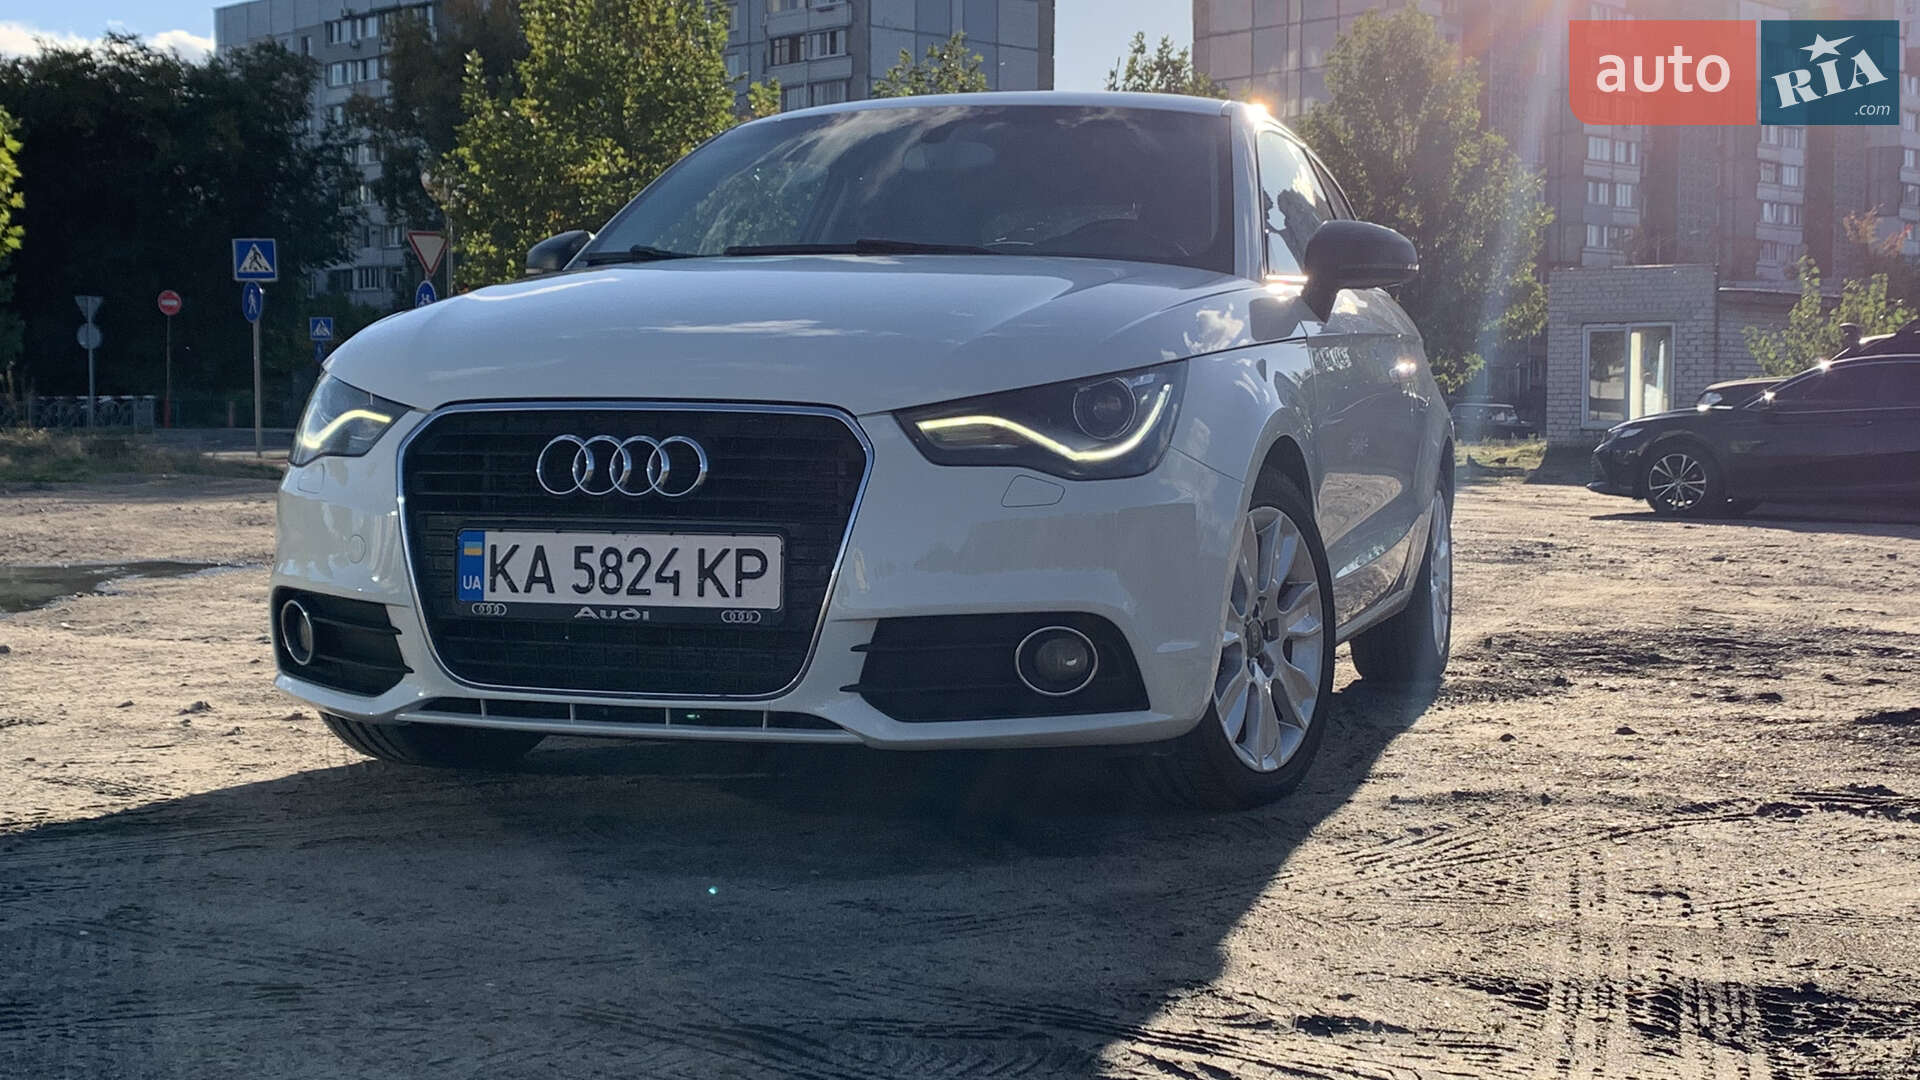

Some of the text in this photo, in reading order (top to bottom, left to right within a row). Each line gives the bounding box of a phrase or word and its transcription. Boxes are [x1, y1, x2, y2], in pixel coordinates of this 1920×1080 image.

[489, 543, 769, 598] KA 5824 KP
[463, 575, 482, 591] UA
[573, 606, 650, 621] Audi
